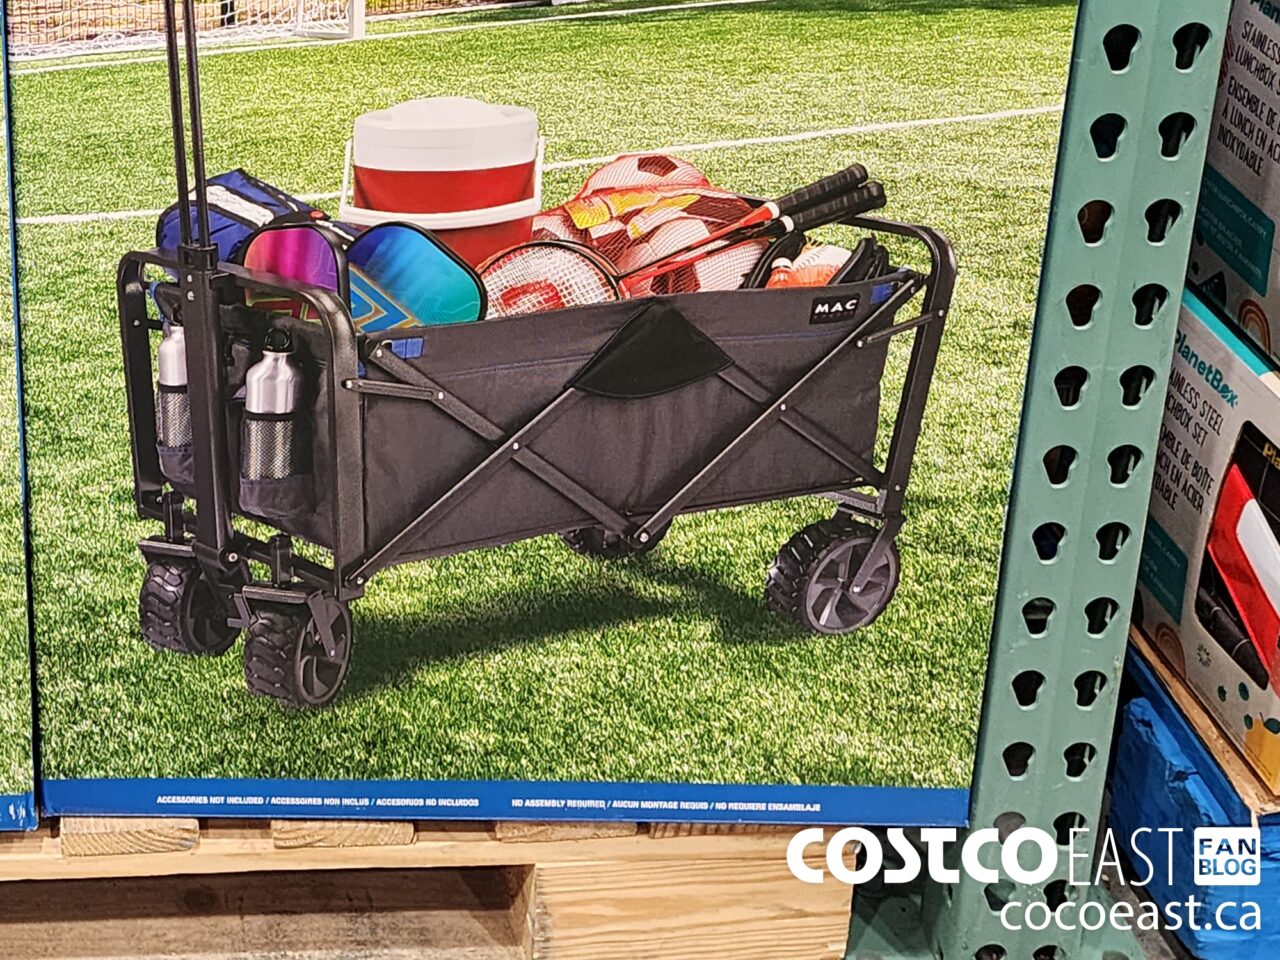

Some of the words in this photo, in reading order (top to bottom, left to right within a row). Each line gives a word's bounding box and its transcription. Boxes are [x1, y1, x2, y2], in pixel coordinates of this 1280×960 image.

[1235, 45, 1275, 88] LUNCHBOX
[1227, 76, 1264, 121] ENSEMBLE
[1267, 108, 1277, 128] DE
[1230, 110, 1255, 136] LUNCH
[1255, 126, 1268, 149] EN
[815, 300, 857, 313] MAC
[1192, 420, 1209, 448] SET
[1200, 400, 1225, 437] STEEL
[1170, 463, 1182, 484] EN
[1183, 478, 1205, 515] ACIER
[1181, 447, 1192, 471] DE
[1193, 461, 1215, 496] BOÎTE
[157, 796, 208, 805] ACCESSORIES
[209, 796, 225, 805] NOT
[227, 796, 264, 805] INCLUDED
[270, 796, 322, 805] ACCESSOIRES
[324, 797, 340, 806] NON
[342, 797, 369, 806] INCLUS
[376, 798, 424, 807] ACCESORIOS
[425, 798, 436, 807] NO
[438, 798, 479, 807] INCLUIDOS
[512, 799, 523, 807] NO
[524, 799, 565, 808] ASSEMBLY
[612, 800, 639, 809] AUCUN
[640, 801, 678, 809] MONTAGE
[680, 802, 708, 810] REQUIS
[715, 802, 727, 810] NO
[728, 802, 766, 811] REQUIERE
[768, 803, 821, 812] ENSAMBLAJE
